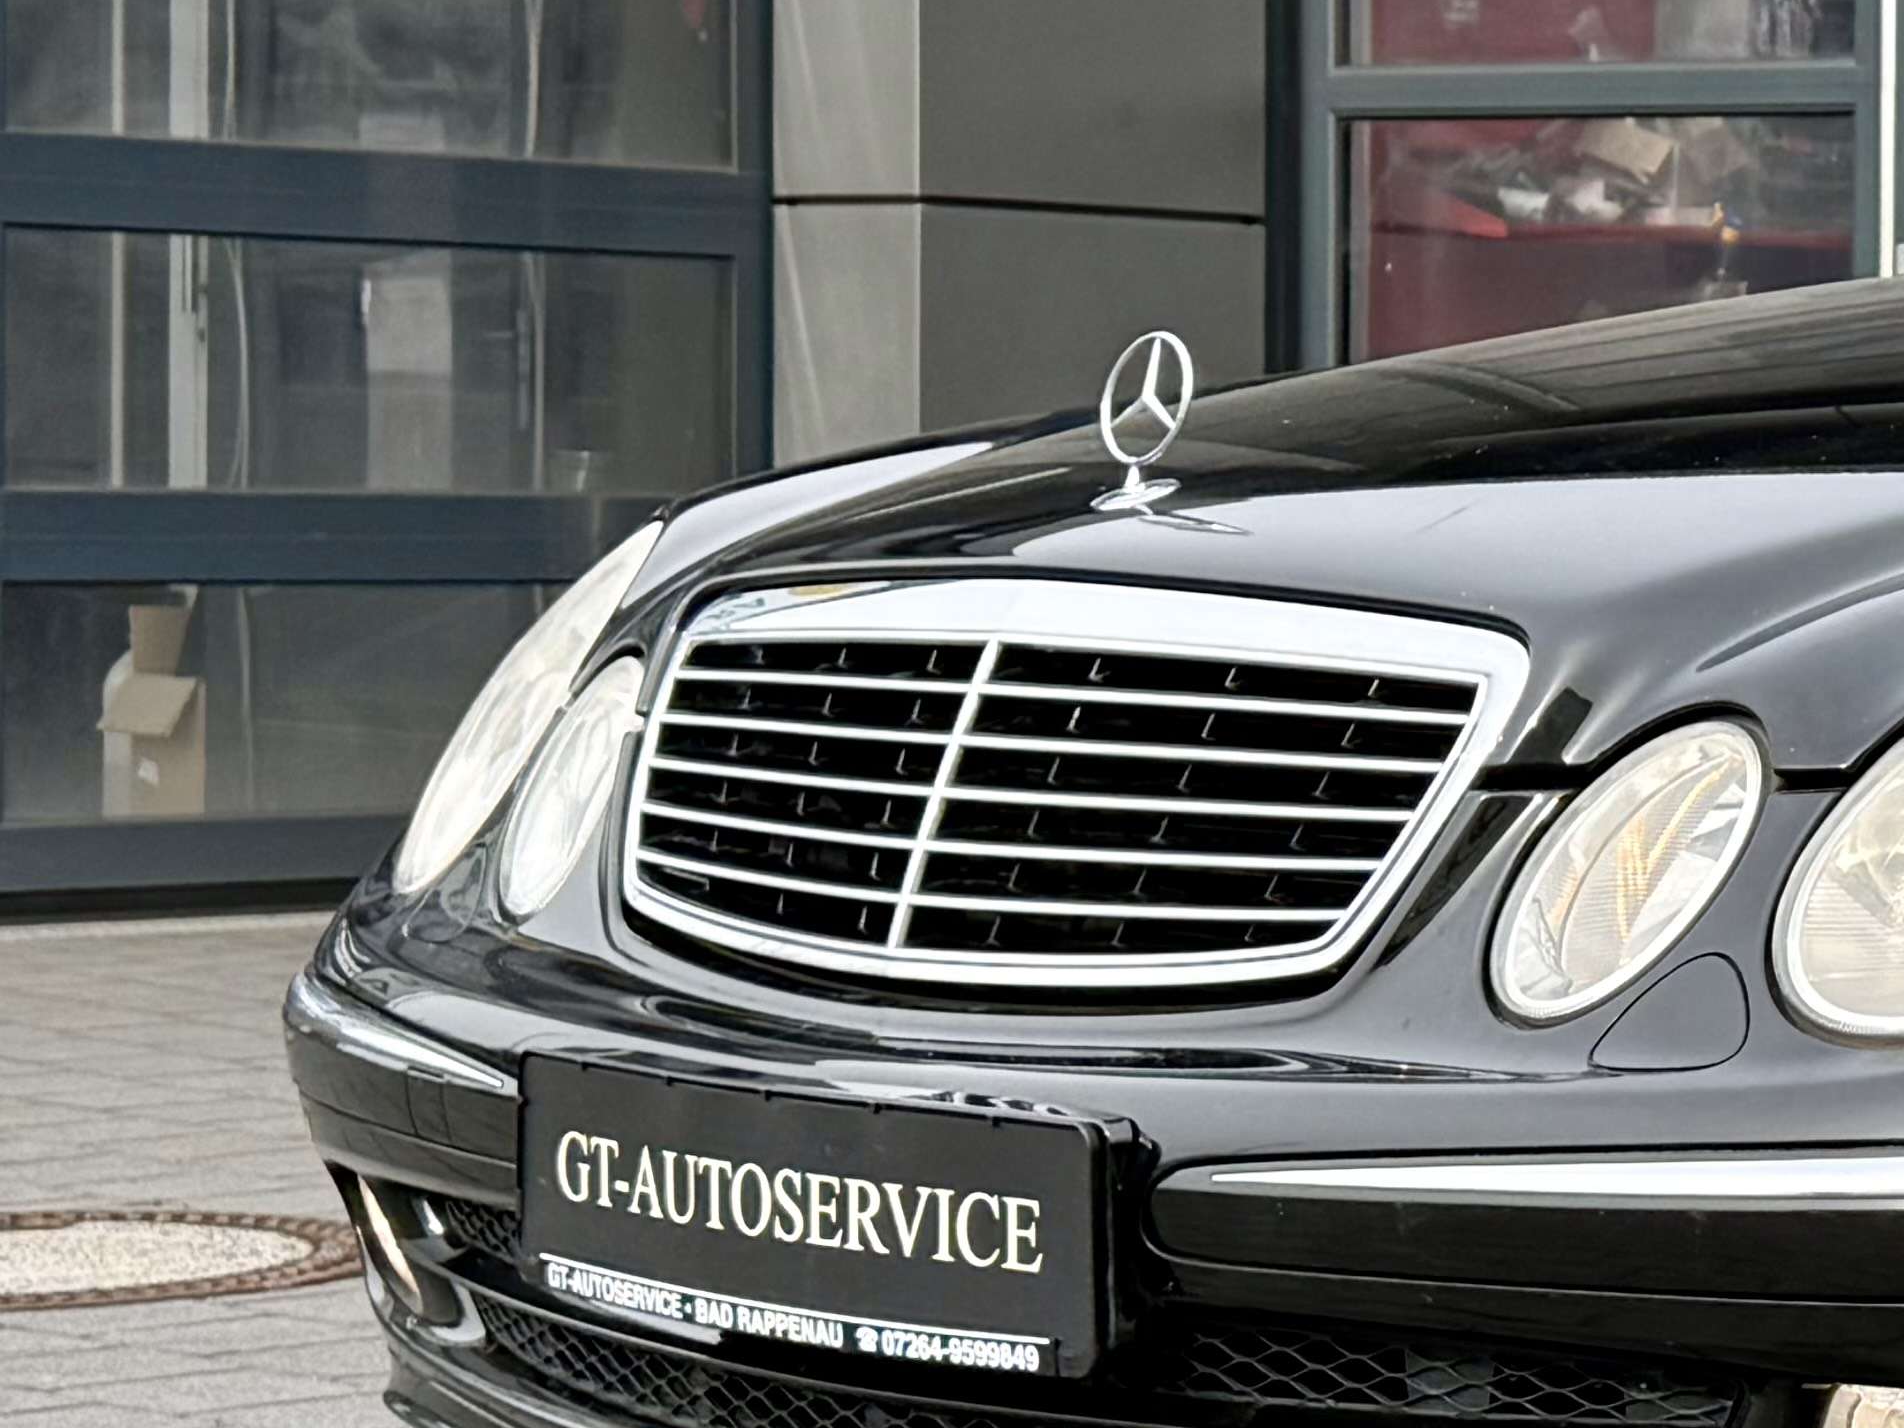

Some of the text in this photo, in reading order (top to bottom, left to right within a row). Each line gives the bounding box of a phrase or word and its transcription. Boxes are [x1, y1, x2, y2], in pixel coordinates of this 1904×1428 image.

[555, 1129, 1044, 1274] GT-AUTOSERVICE
[546, 1261, 685, 1319] GT-AUTOSERVICE
[694, 1296, 734, 1329] BAD
[736, 1305, 844, 1349] RAPPENAU
